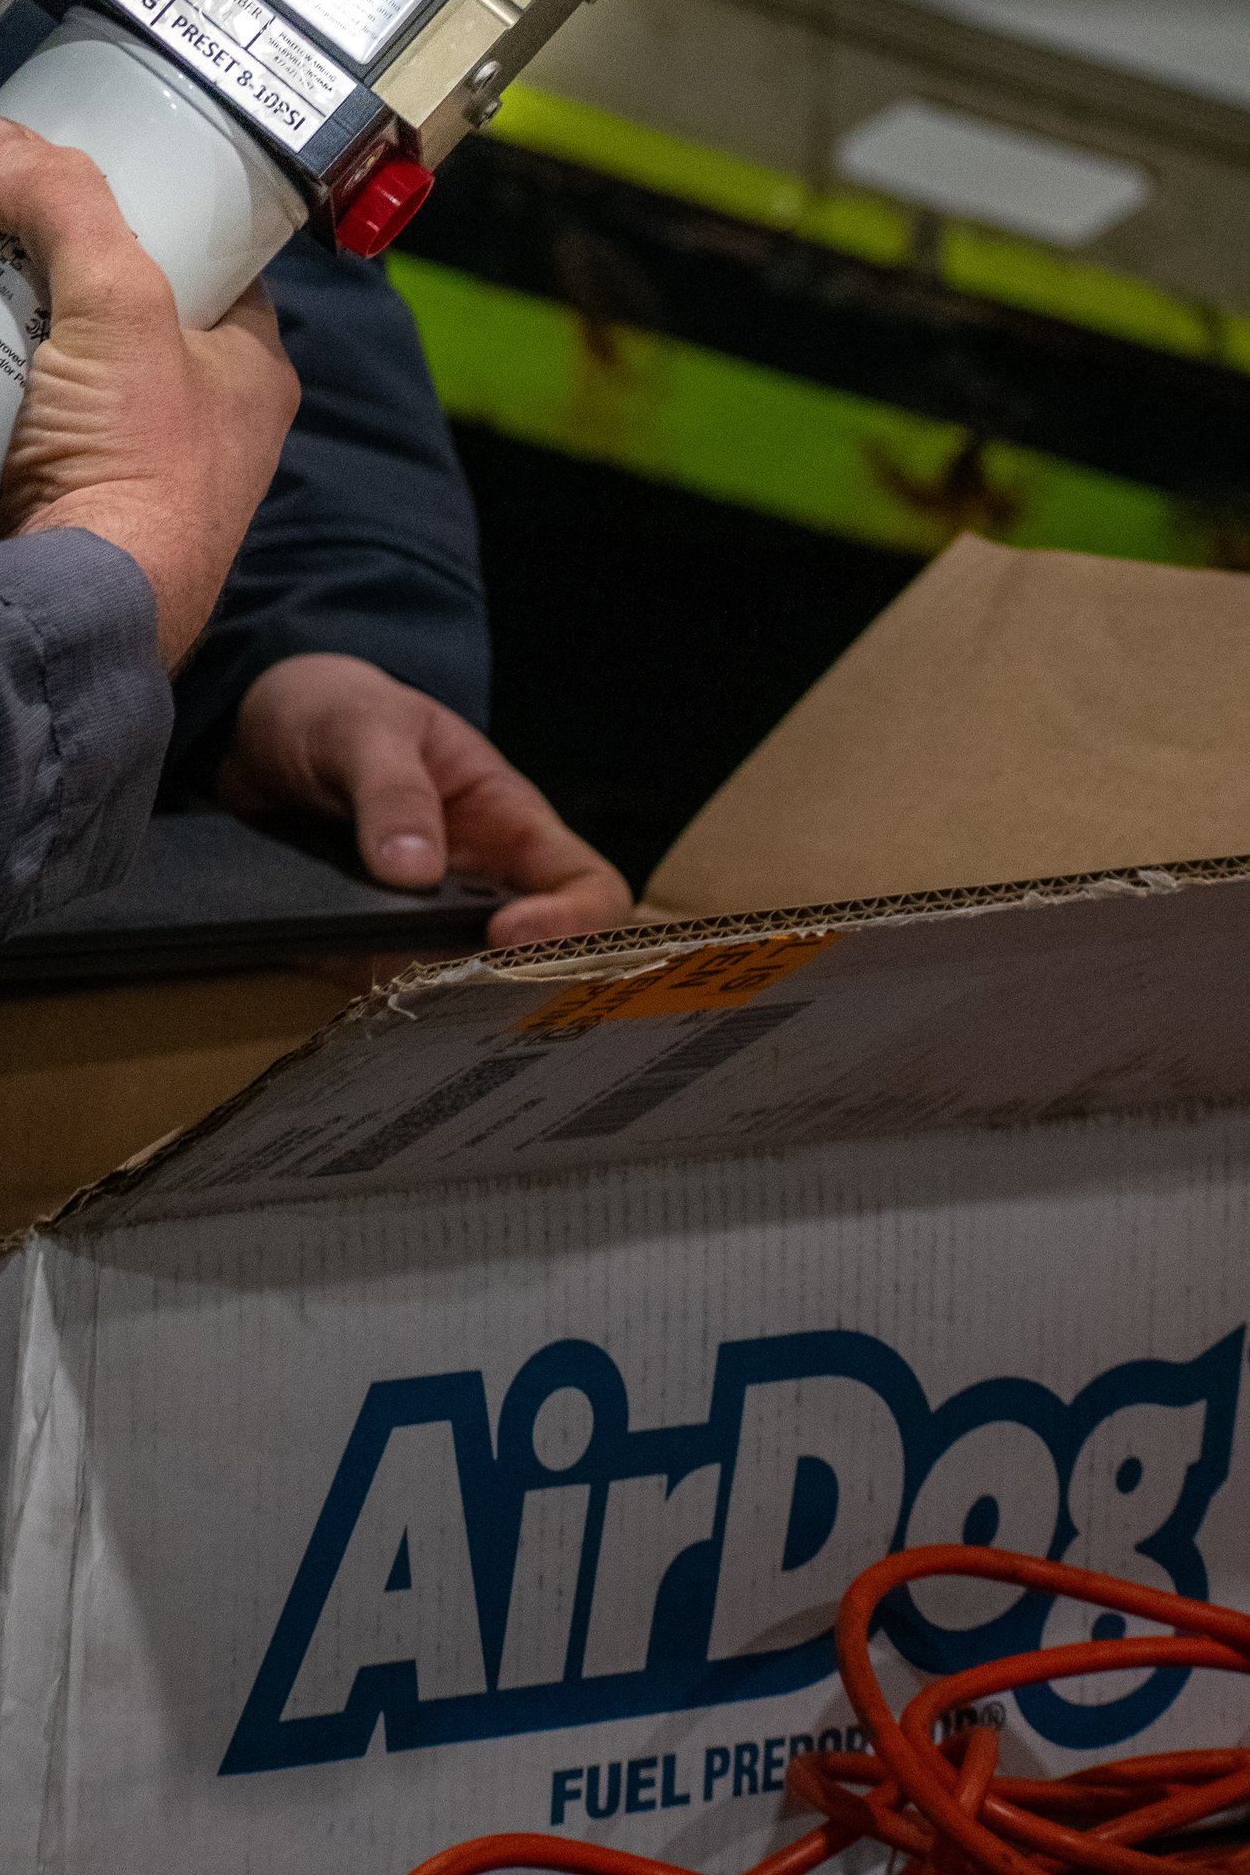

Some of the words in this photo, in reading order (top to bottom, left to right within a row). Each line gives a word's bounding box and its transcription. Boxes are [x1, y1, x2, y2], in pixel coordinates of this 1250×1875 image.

[169, 13, 240, 77] PRESET
[217, 1323, 1250, 1778] AirDog
[551, 1753, 691, 1826] FUEL
